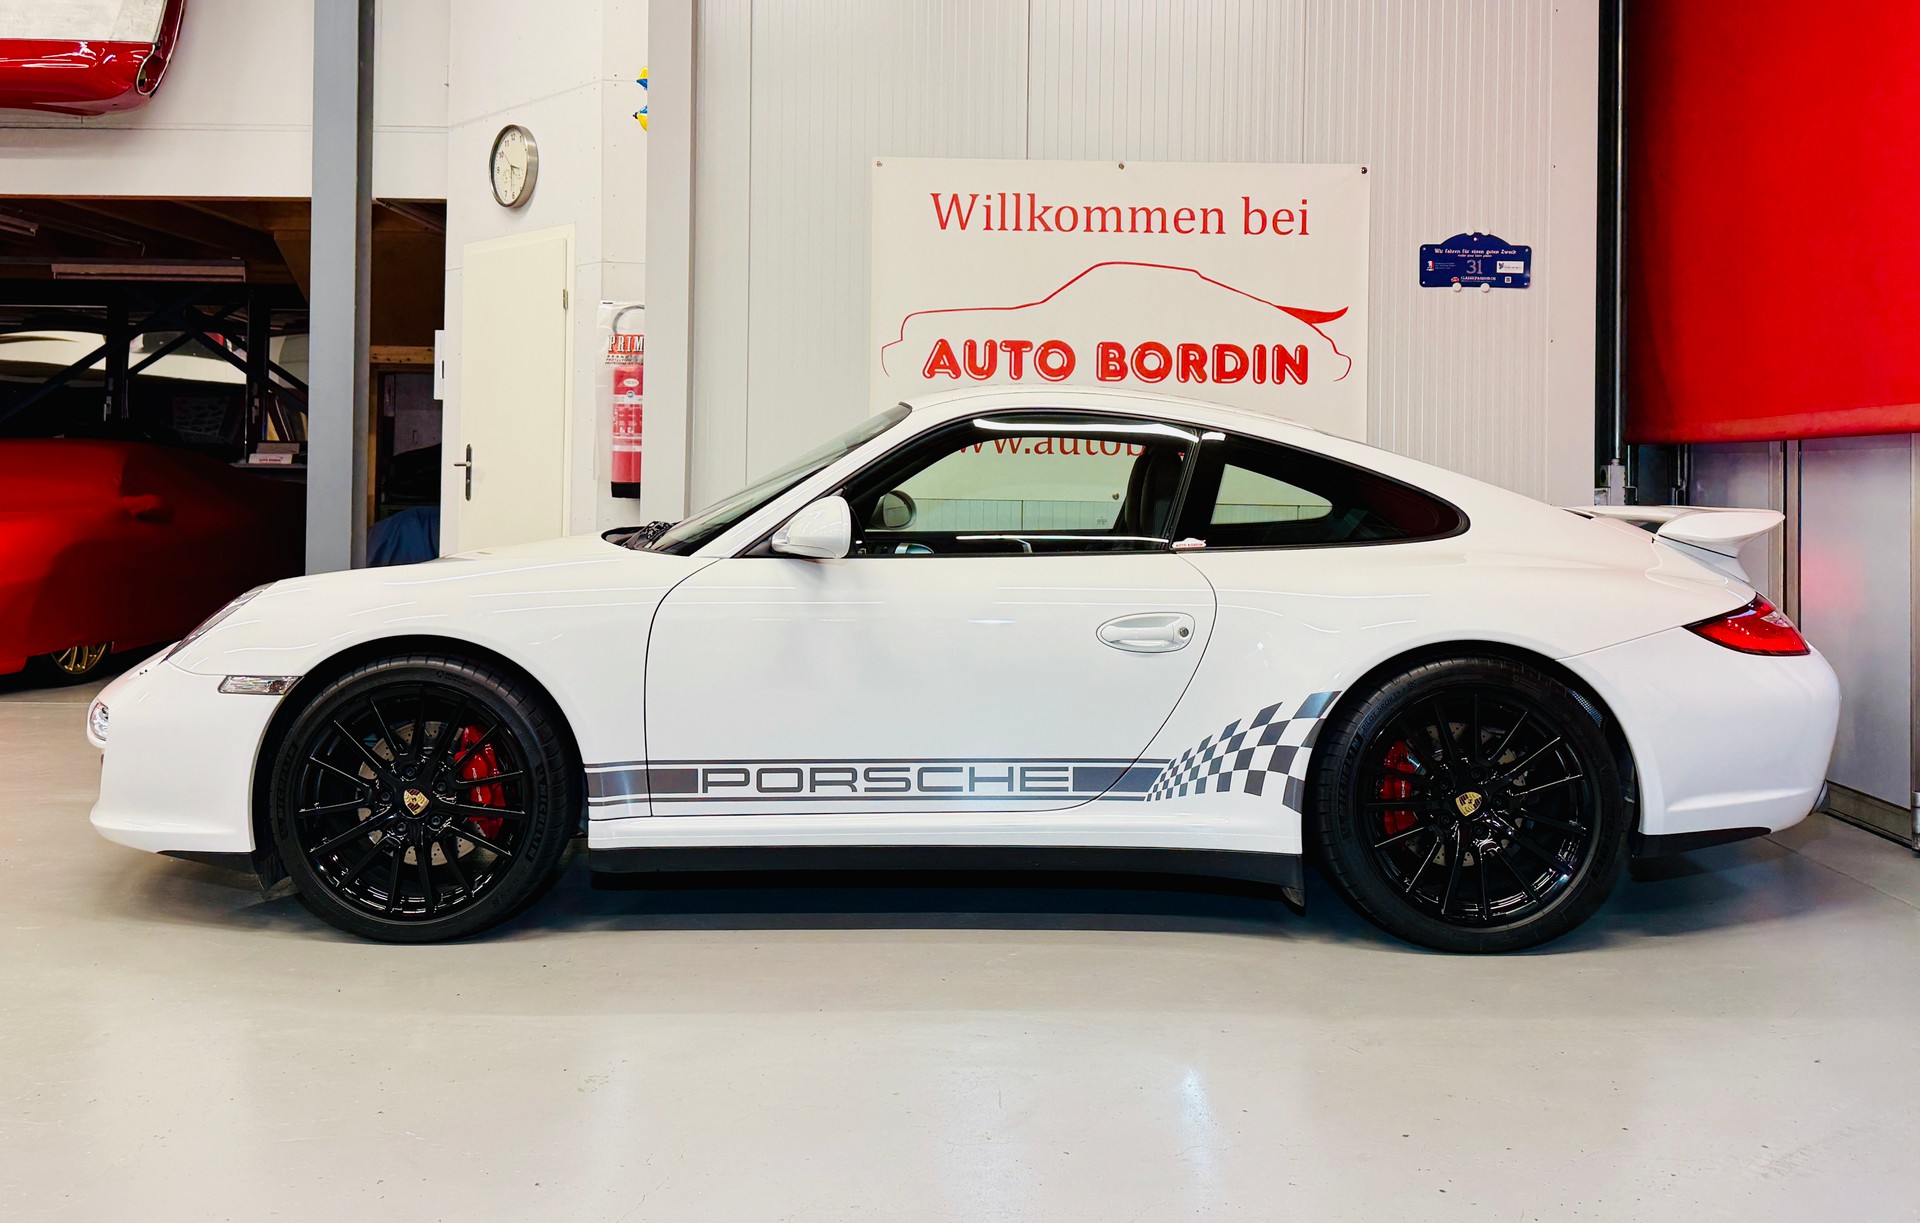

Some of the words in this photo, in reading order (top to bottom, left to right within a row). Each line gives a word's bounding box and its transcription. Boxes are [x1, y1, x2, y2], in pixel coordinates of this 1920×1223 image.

[504, 139, 510, 148] 11
[510, 132, 516, 141] 12
[499, 150, 505, 159] 10
[931, 192, 1225, 235] Willkommen
[1243, 195, 1309, 236] bei
[1466, 259, 1483, 274] 31
[922, 338, 1077, 383] AUTO
[1095, 340, 1309, 386] BORDIN
[960, 436, 1146, 457] w.auto
[702, 766, 1069, 793] PORSCHE
